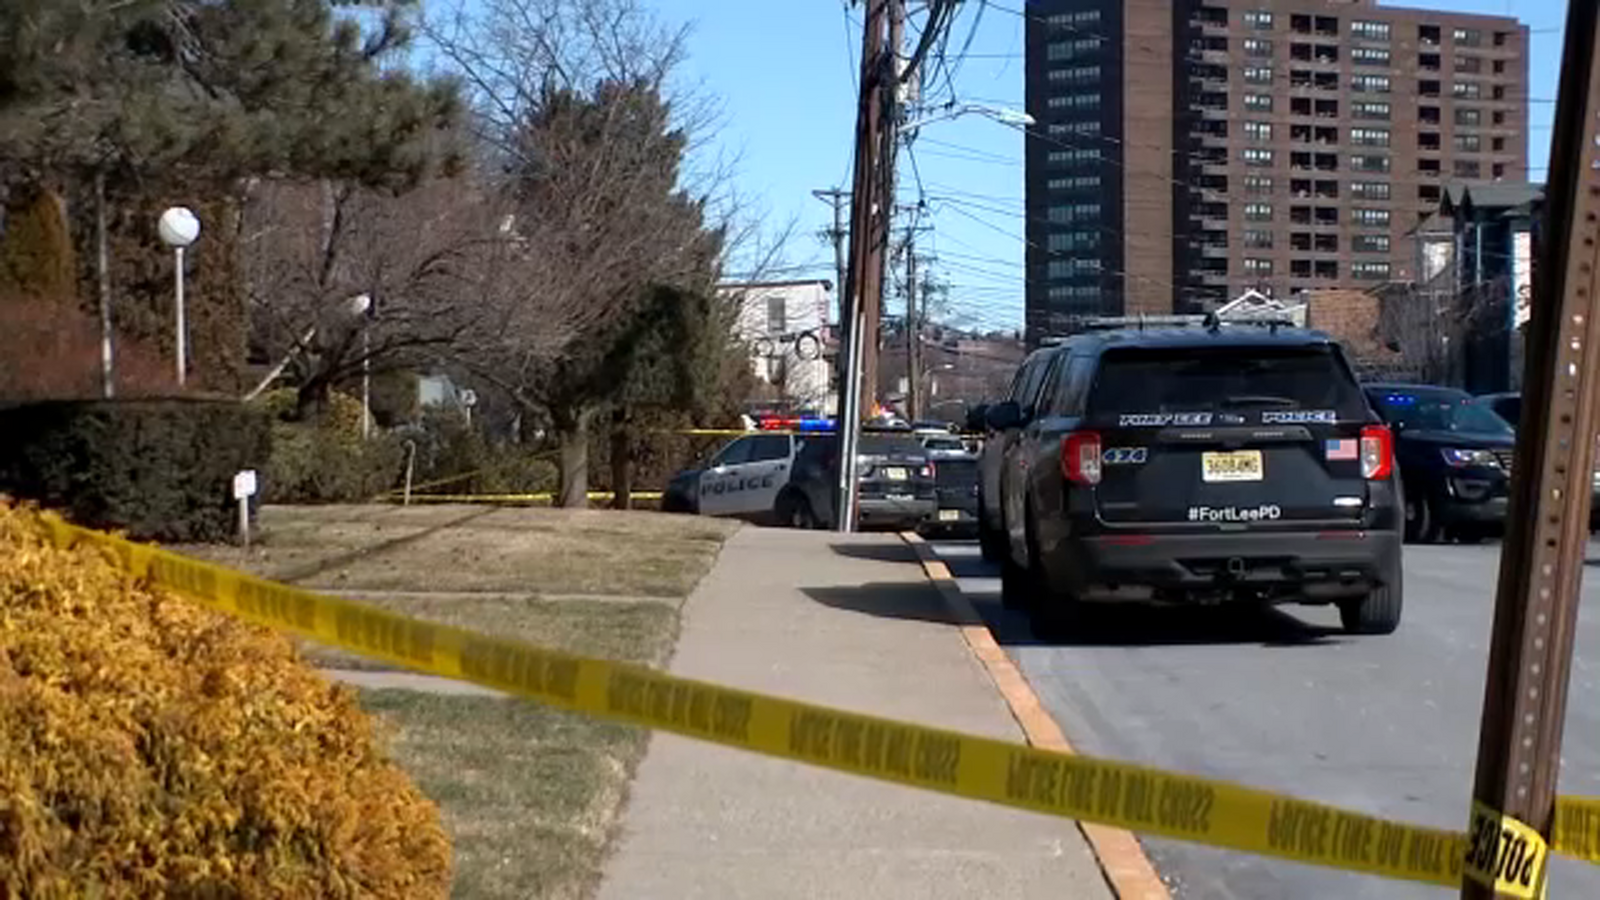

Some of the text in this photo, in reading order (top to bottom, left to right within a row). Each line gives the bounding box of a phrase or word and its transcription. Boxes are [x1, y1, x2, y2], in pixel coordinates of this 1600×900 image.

[1261, 410, 1336, 425] POLICE
[701, 476, 774, 496] POLICE
[1188, 504, 1281, 522] #FortLeePD
